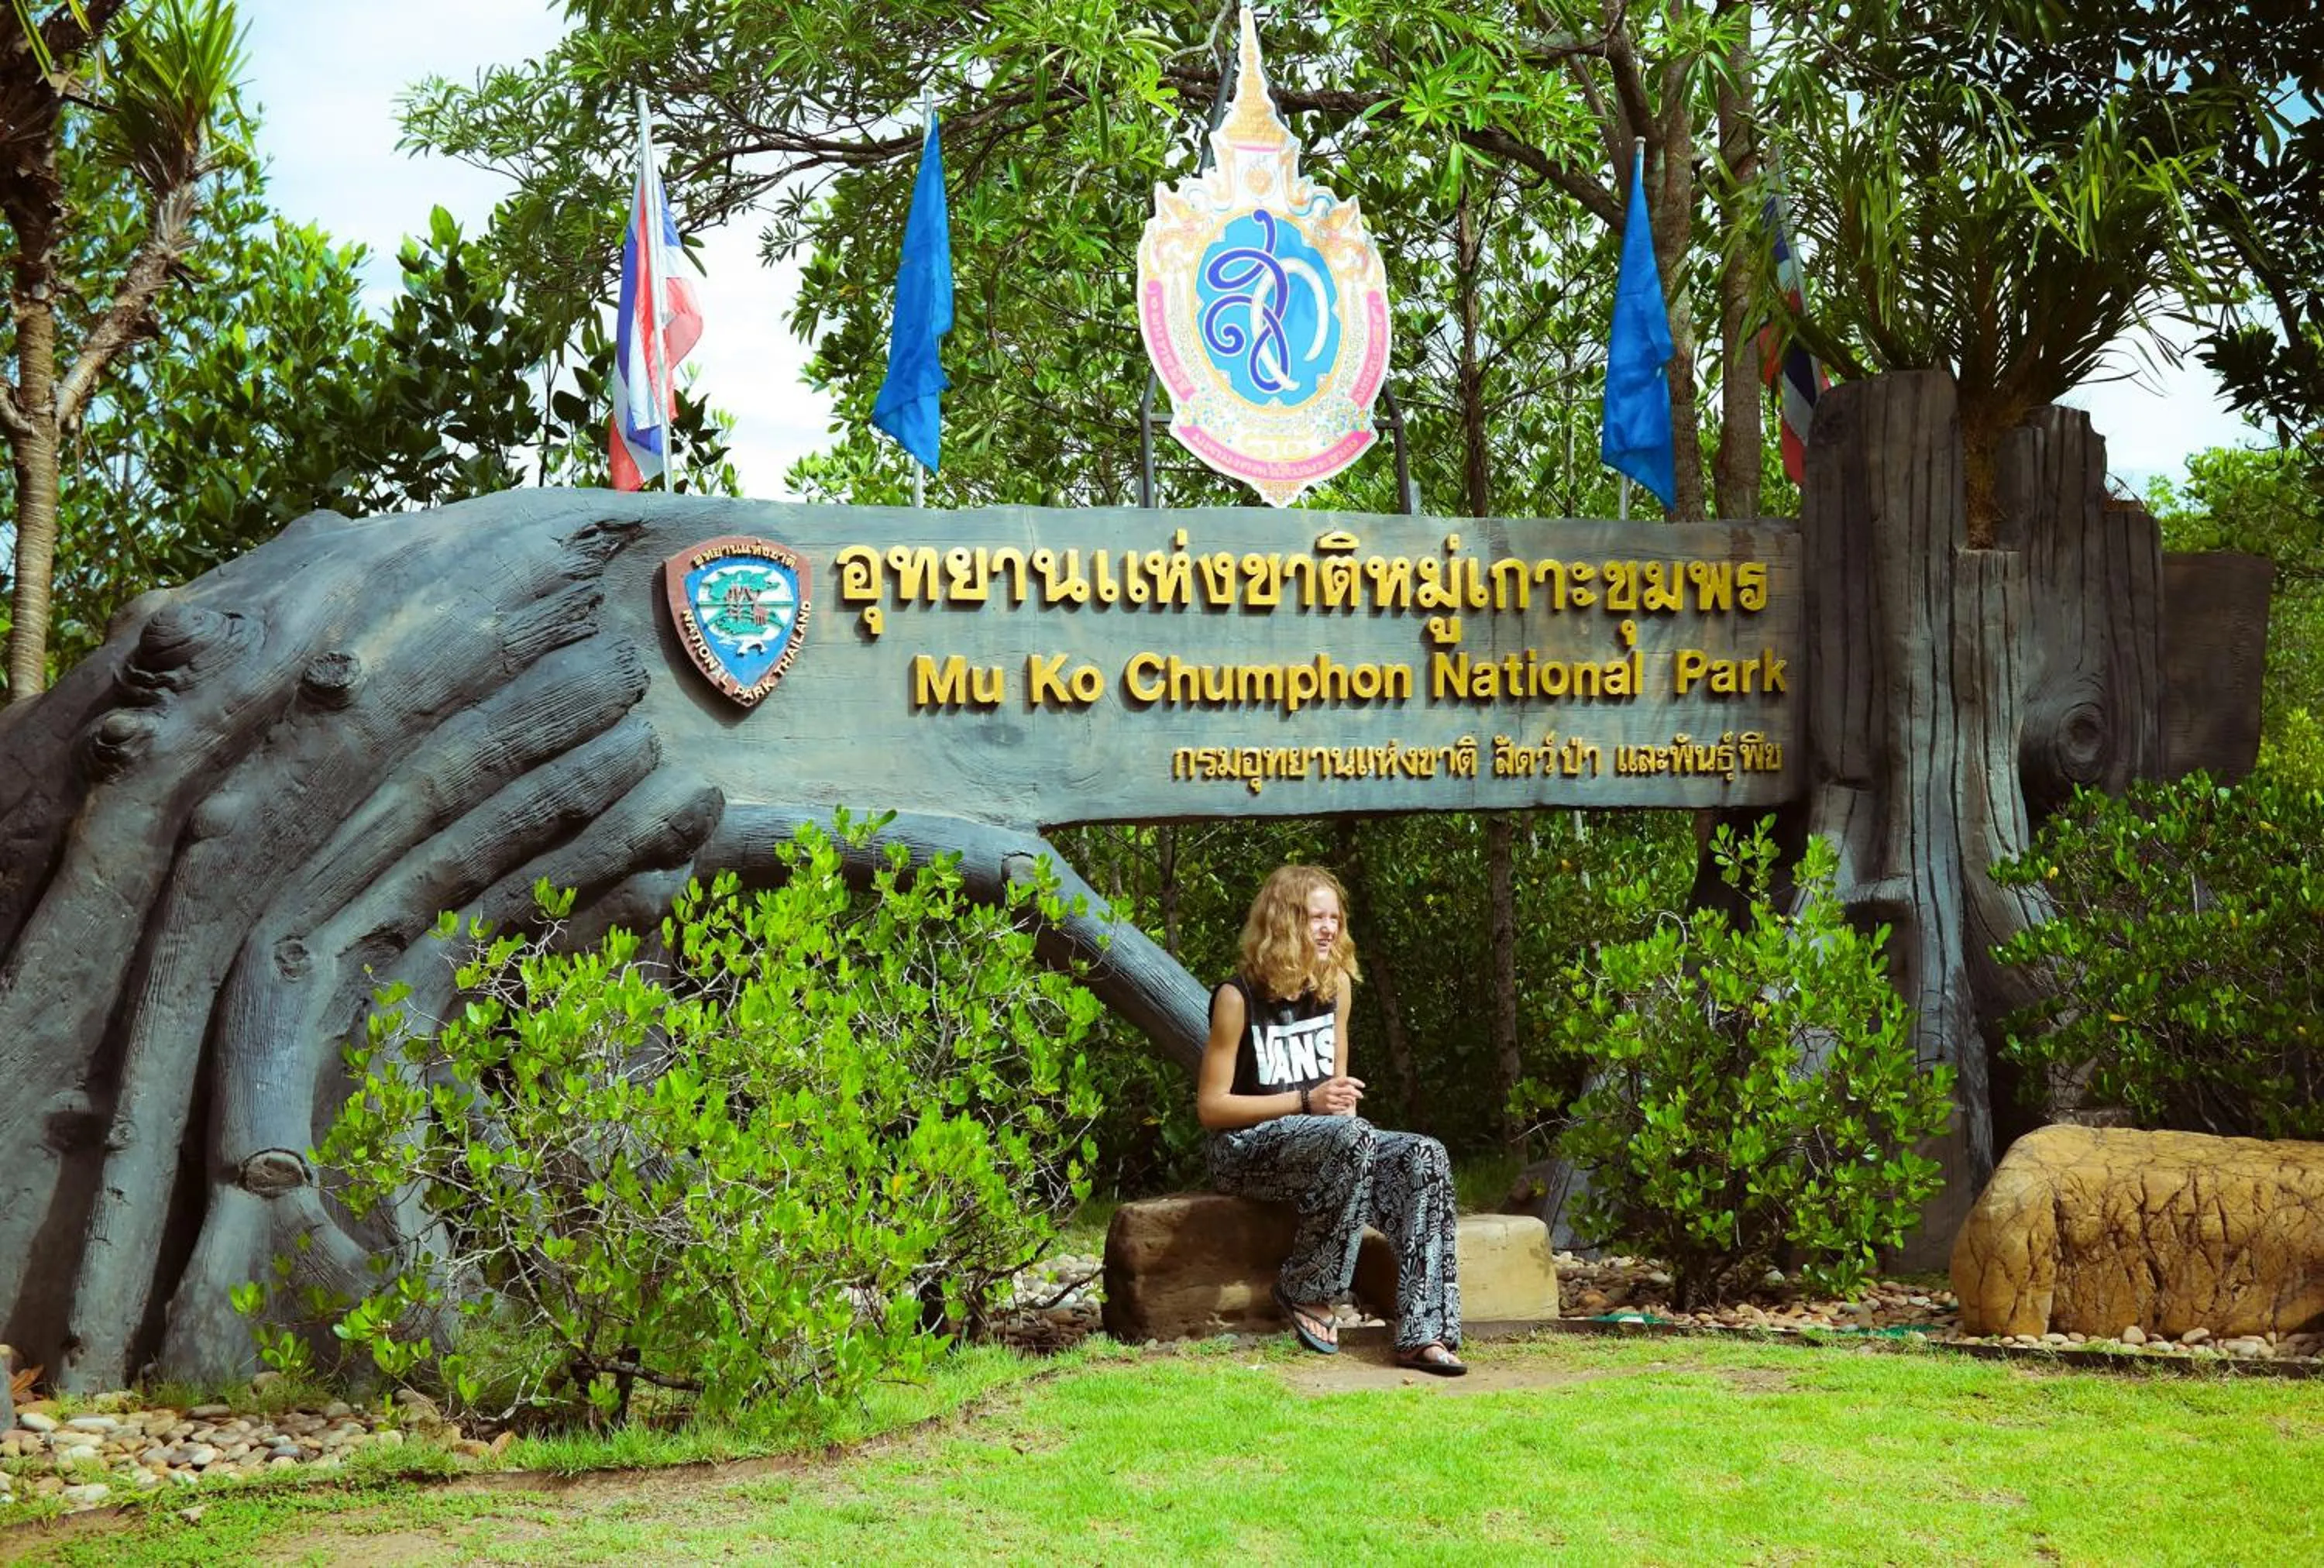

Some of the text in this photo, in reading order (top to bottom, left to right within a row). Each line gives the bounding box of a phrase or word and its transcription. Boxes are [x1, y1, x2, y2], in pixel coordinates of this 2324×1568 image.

[682, 600, 811, 700] NATIONAL PARK THAILAND
[916, 648, 1787, 712] Mu Ko Chumphon National Park
[1174, 735, 1479, 794] กรมอุทยานแห่งชาติ
[1494, 730, 1601, 775] สัตว์ป่า
[1251, 1013, 1334, 1085] VANS
